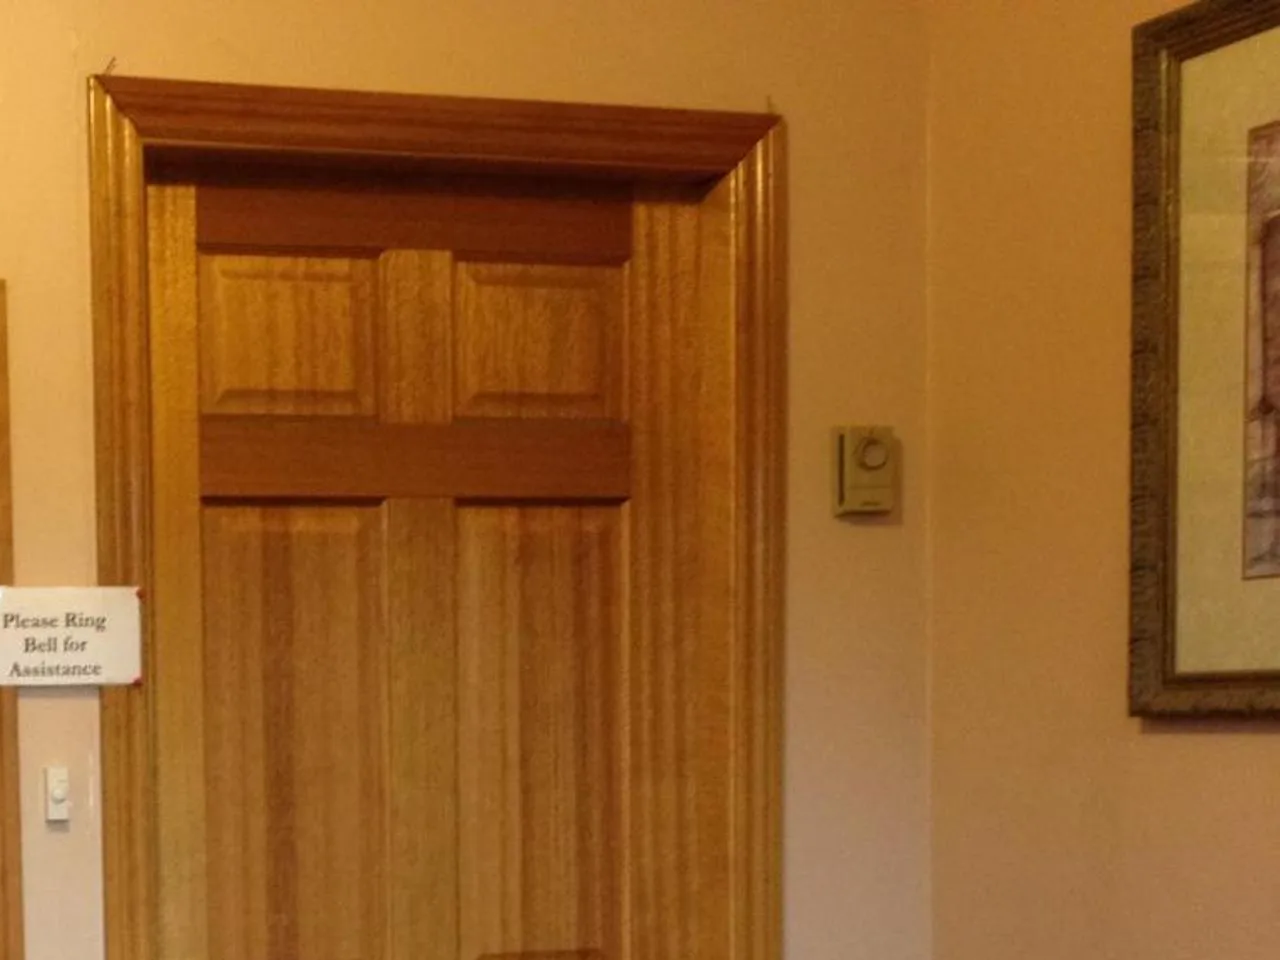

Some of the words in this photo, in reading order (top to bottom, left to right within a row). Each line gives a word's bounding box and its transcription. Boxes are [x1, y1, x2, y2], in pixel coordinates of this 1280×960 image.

[2, 613, 59, 629] Please
[64, 612, 107, 632] Ring
[24, 637, 57, 653] Bell
[63, 636, 89, 652] for
[8, 661, 102, 677] Assistance
